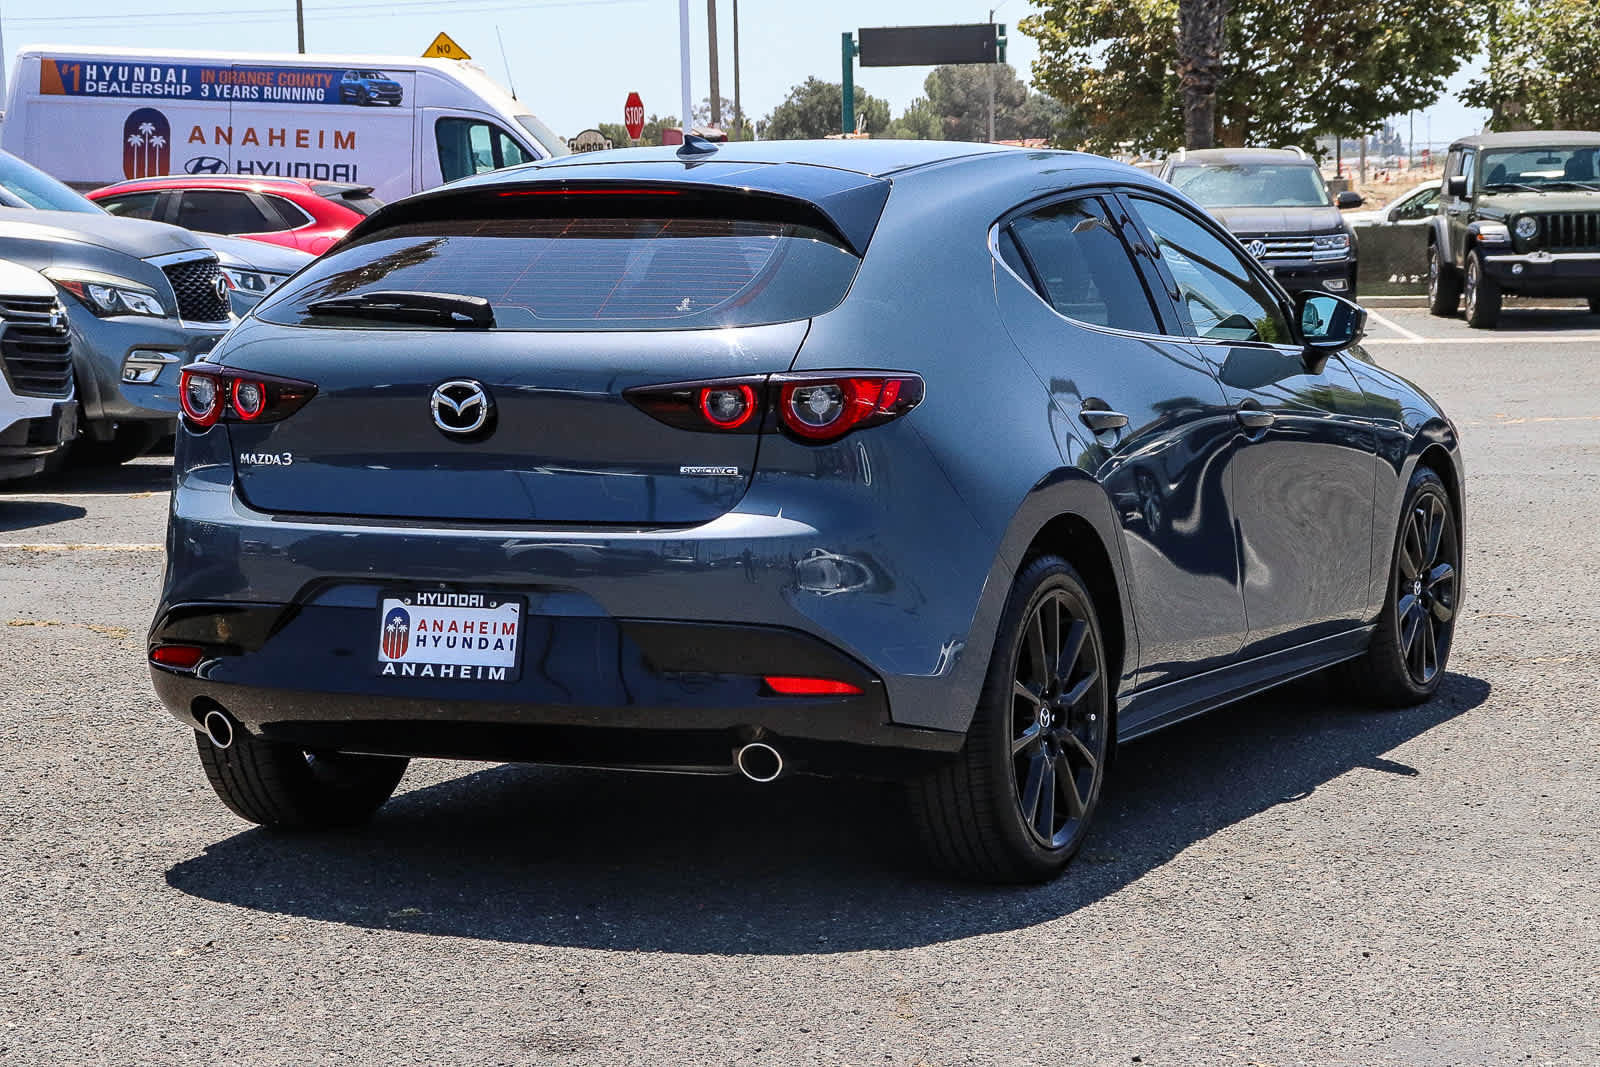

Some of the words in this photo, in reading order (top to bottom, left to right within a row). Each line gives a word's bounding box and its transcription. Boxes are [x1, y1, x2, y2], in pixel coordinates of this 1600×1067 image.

[436, 44, 451, 54] NO
[86, 65, 187, 84] HYUNDAI
[201, 69, 215, 83] IN
[220, 71, 274, 86] ORANGE
[278, 72, 333, 88] COUNTY
[85, 81, 192, 96] DEALERSHIP
[200, 84, 210, 97] 3
[214, 84, 259, 99] YEARS
[263, 86, 325, 101] RUNNING
[625, 107, 643, 125] STOP
[188, 125, 356, 150] ANAHEIM
[417, 592, 484, 608] HYUNDAI
[417, 619, 516, 635] ANAHEIM
[416, 634, 514, 651] HYUNDAI
[382, 662, 506, 681] ANAHEIM
